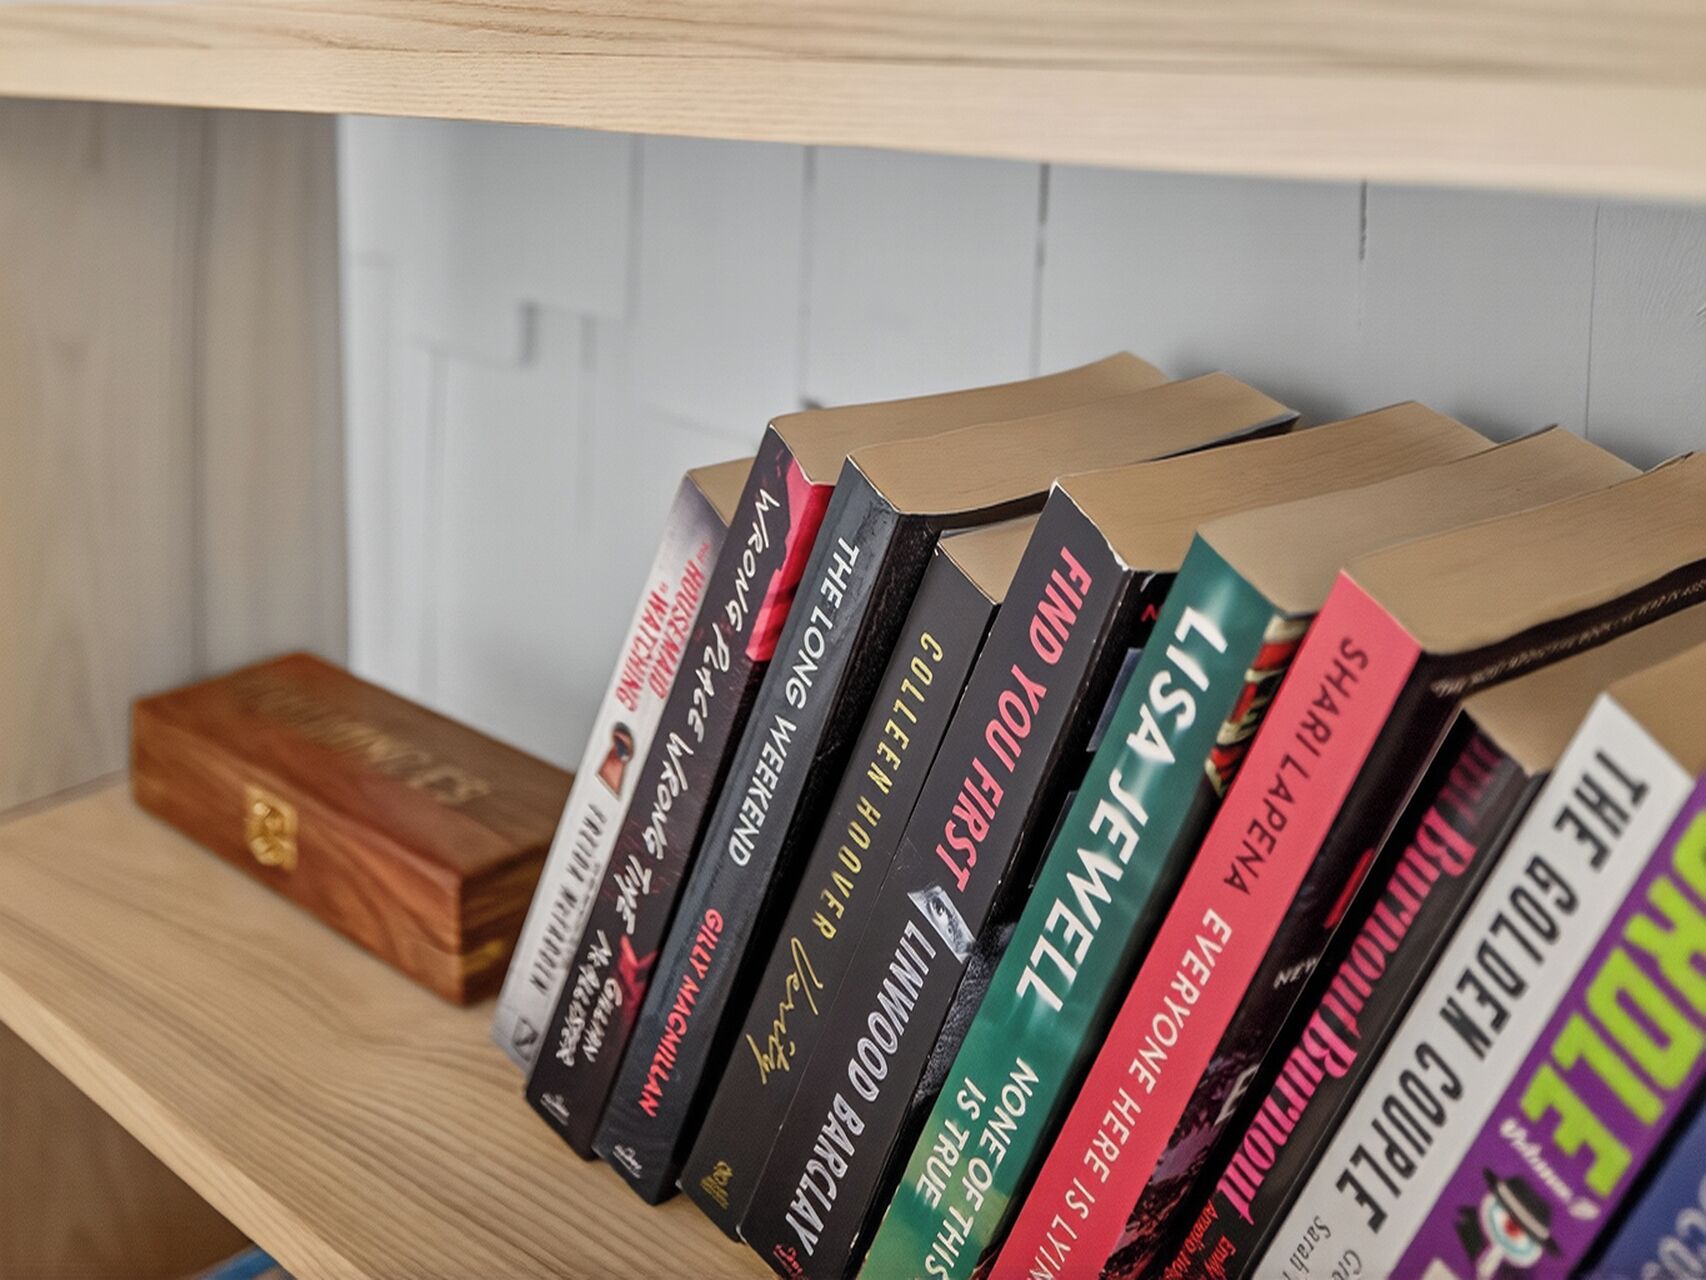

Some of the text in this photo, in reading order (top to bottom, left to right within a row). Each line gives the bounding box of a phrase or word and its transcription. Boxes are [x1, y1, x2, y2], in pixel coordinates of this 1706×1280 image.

[614, 489, 780, 935] WRONG PLACE WRONG TIME
[616, 591, 669, 712] WATCHING
[649, 560, 705, 700] HOUSEMAID
[728, 537, 860, 867] THE LONG WEEKEND
[935, 546, 1093, 893] FIND YOU FIRST
[812, 632, 944, 940] COLLEEN HOOVER
[1016, 606, 1229, 1012] LISA JEWELL
[1223, 637, 1369, 896] SHARI LAPENA
[1554, 750, 1651, 874] THE
[638, 908, 724, 1118] GILLY MACMILLAN
[746, 937, 824, 1085] Verity
[847, 920, 936, 1102] LINWOOD
[1129, 908, 1232, 1095] EVERYONE
[1317, 805, 1478, 1039] Burnout
[1439, 855, 1580, 1061] GOLDEN
[1520, 810, 1706, 1198] RDLE
[582, 978, 622, 1062] GILLIAN
[785, 1093, 866, 1257] BARCLAY
[916, 1077, 987, 1210] IS TRUE
[925, 1057, 1040, 1280] NONE OF THIS
[1065, 1177, 1096, 1220] IS
[1084, 1088, 1141, 1184] HERE
[1216, 1012, 1360, 1226] Burnout
[1335, 1041, 1465, 1235] COUPLE
[1289, 1216, 1331, 1274] Sarah
